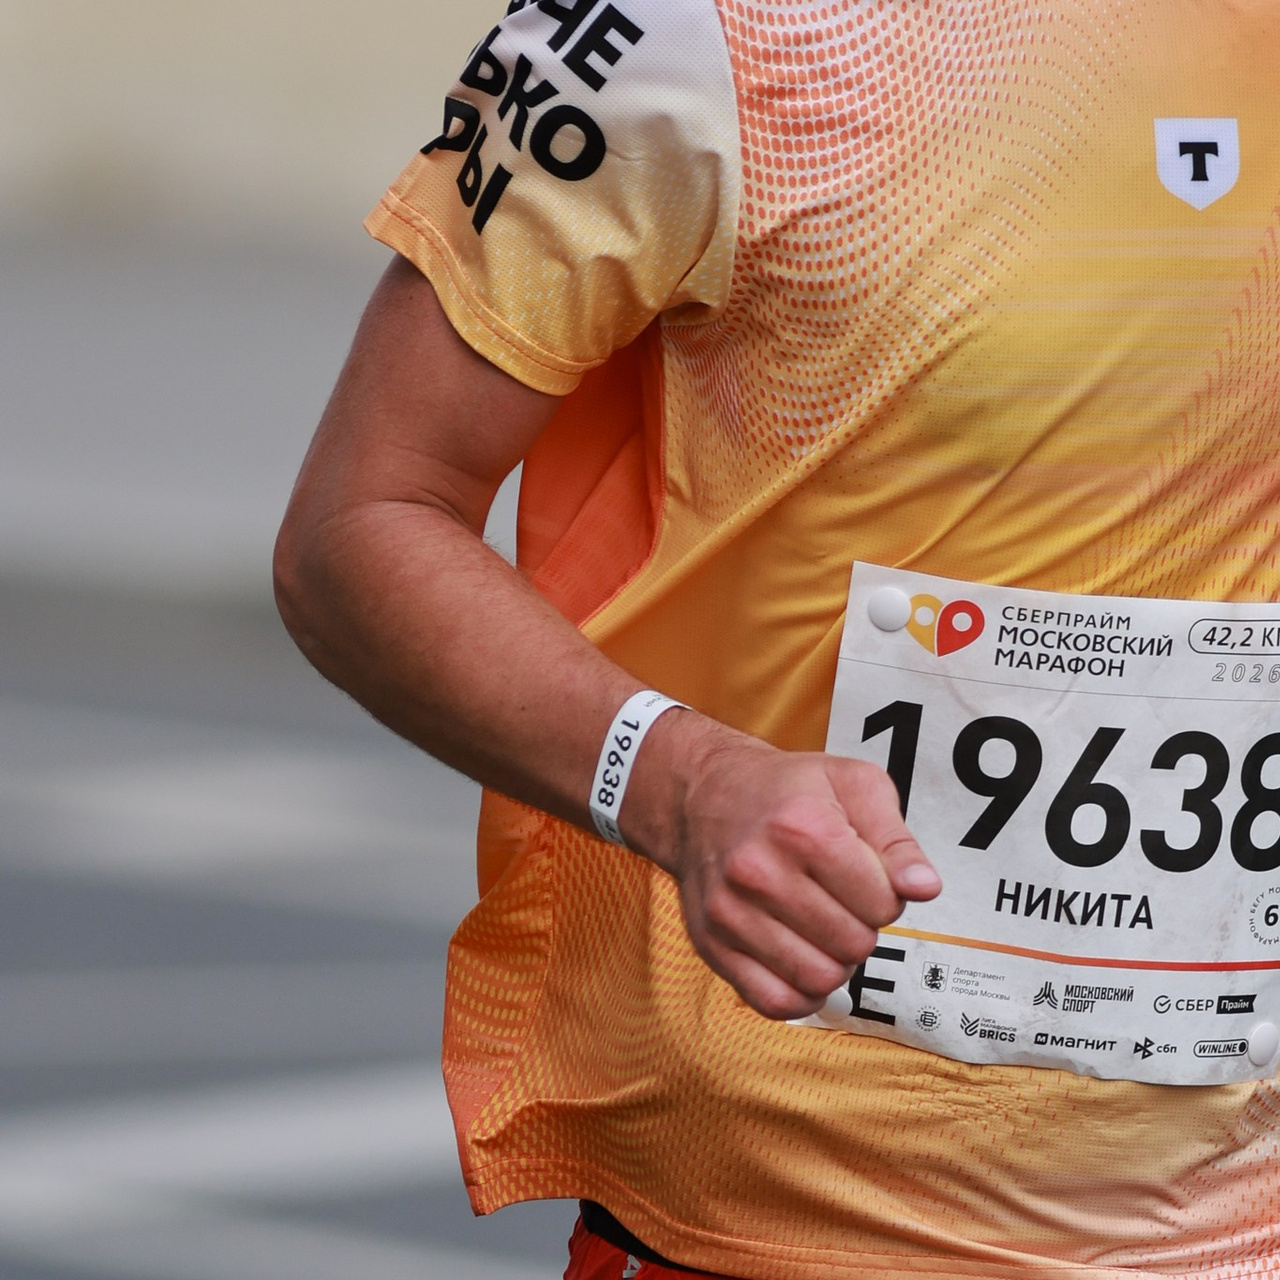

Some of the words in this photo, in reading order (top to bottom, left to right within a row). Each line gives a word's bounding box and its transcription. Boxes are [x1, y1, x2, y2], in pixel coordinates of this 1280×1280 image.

[460, 25, 607, 182] ЬКО
[1179, 141, 1219, 182] Т
[1001, 605, 1131, 631] СБЕРПРАЙМ
[998, 624, 1174, 657] МОСКОВСКИЙ
[1202, 626, 1254, 650] 42,2
[994, 648, 1126, 677] МАРАФОН
[597, 719, 640, 808] 19638
[994, 878, 1154, 930] НИКИТА
[1264, 904, 1279, 927] 6
[952, 977, 980, 988] спорта
[953, 967, 1006, 982] Департамент
[951, 986, 979, 997] города
[979, 989, 1011, 1001] Москвы
[1063, 984, 1135, 1002] МОСКОВСКИЙ
[1061, 998, 1097, 1014] СПОРТ
[1175, 998, 1215, 1012] СБЕР
[1219, 998, 1251, 1011] Прайм
[978, 1029, 1017, 1043] BRICS
[1156, 1043, 1178, 1054] сбп
[1198, 1042, 1238, 1054] WINLINE
